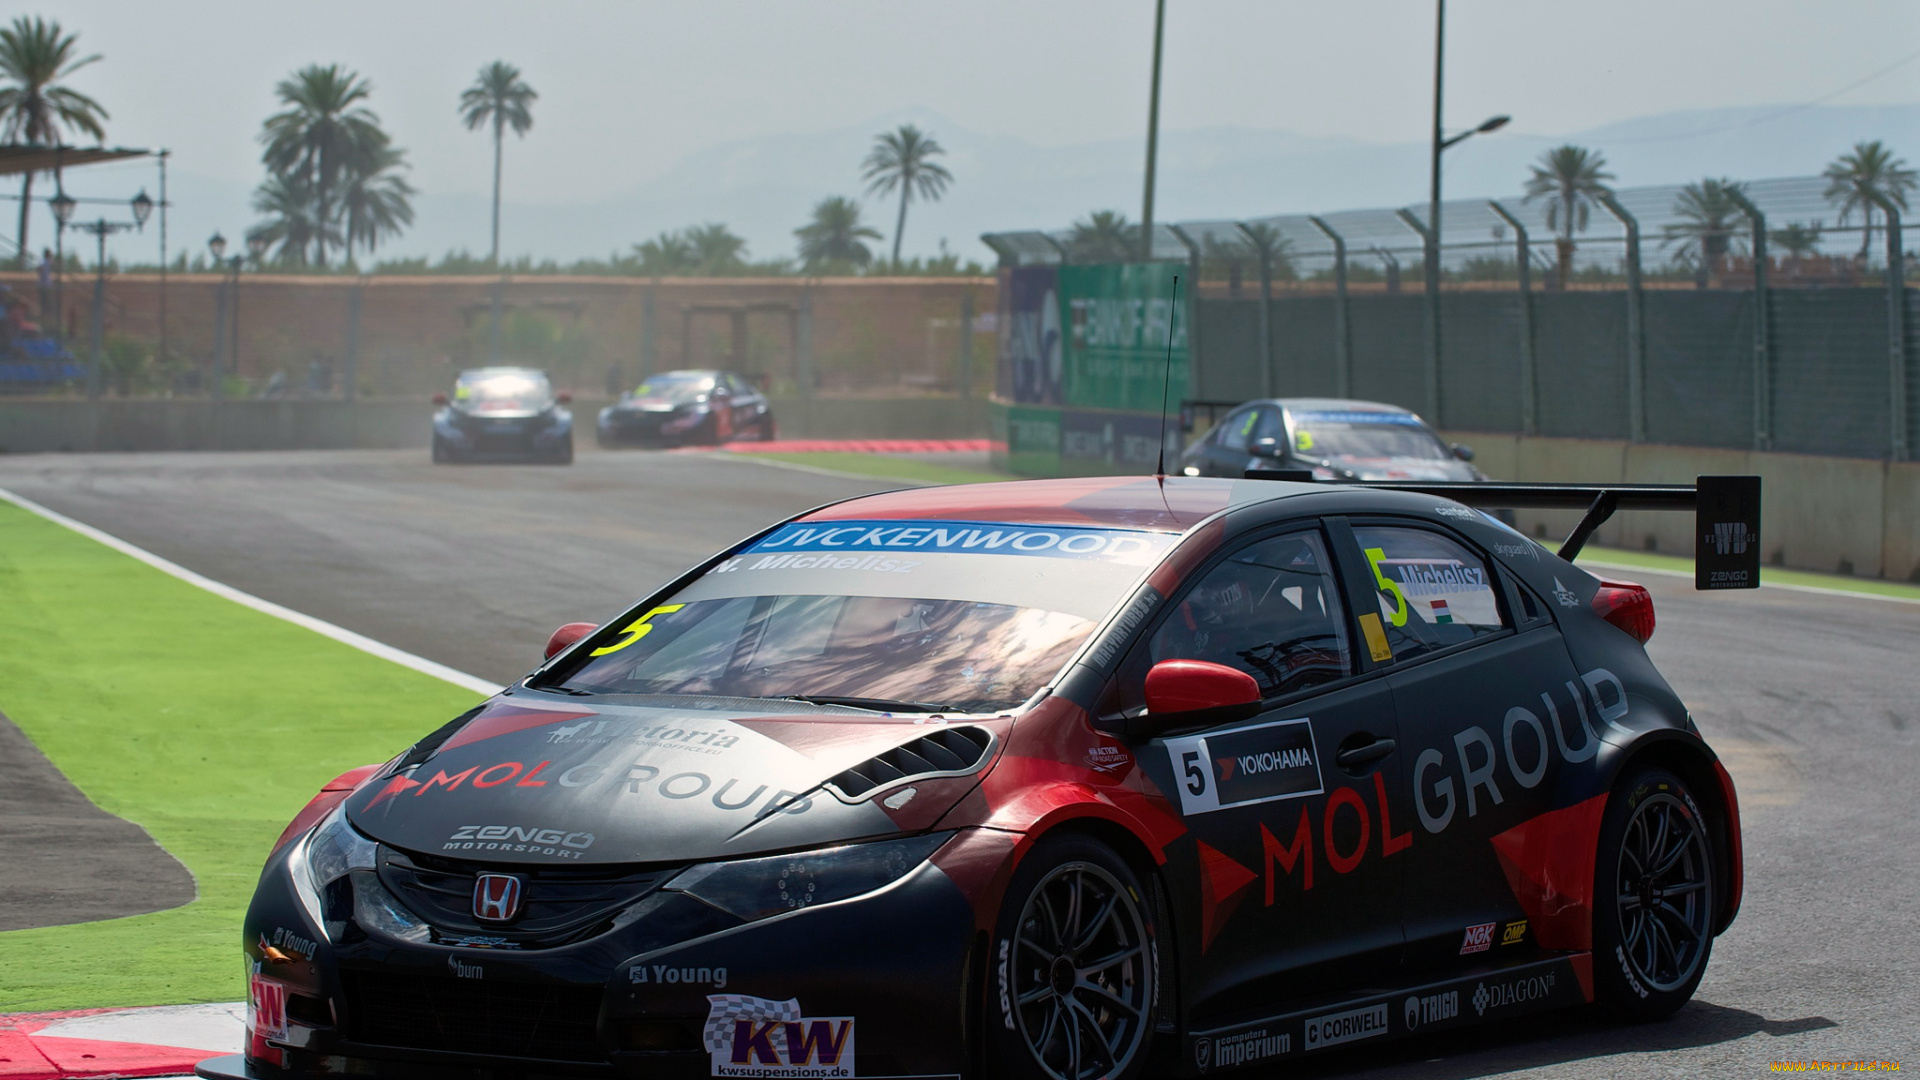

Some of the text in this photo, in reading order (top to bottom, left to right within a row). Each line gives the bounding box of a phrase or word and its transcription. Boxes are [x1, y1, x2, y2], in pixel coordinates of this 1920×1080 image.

[748, 554, 922, 573] Michelisz
[1364, 548, 1408, 627] 5
[1398, 564, 1488, 596] Michelisz
[589, 603, 686, 656] 5
[1182, 751, 1205, 796] 5
[1238, 747, 1312, 775] YOKOHAMA
[442, 841, 586, 860] MOTORSPORT
[282, 929, 317, 961] Young
[1464, 924, 1495, 946] NGK
[1503, 924, 1526, 941] OMP
[457, 960, 483, 979] burn
[653, 965, 727, 988] Young
[1421, 991, 1458, 1022] TRIGO
[1323, 1011, 1386, 1040] CORWELL
[730, 1020, 853, 1066] KW
[1215, 1032, 1291, 1067] Imperium
[718, 1065, 849, 1078] kwsuspensions.de
